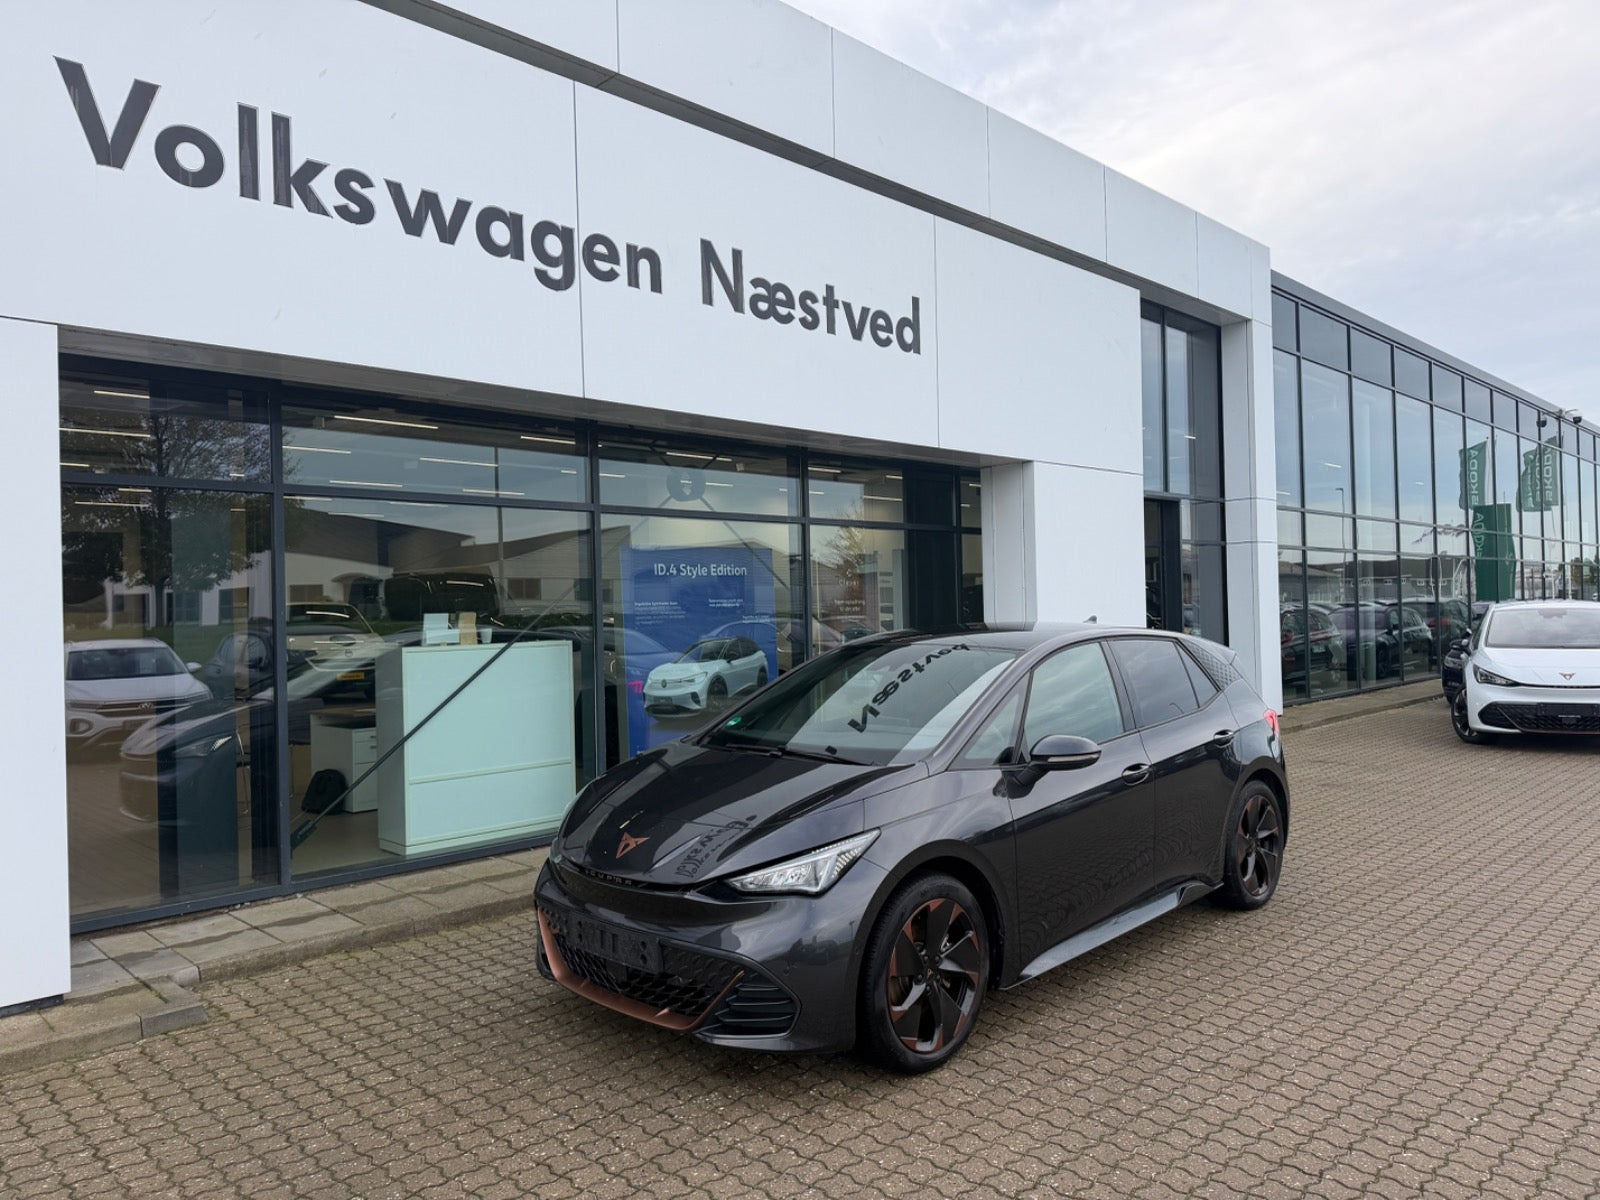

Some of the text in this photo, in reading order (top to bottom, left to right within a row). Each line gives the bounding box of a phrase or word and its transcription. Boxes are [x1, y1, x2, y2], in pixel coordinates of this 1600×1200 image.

[53, 55, 921, 355] Volkswagen Næstved
[654, 563, 747, 579] ID.4 Style Edition
